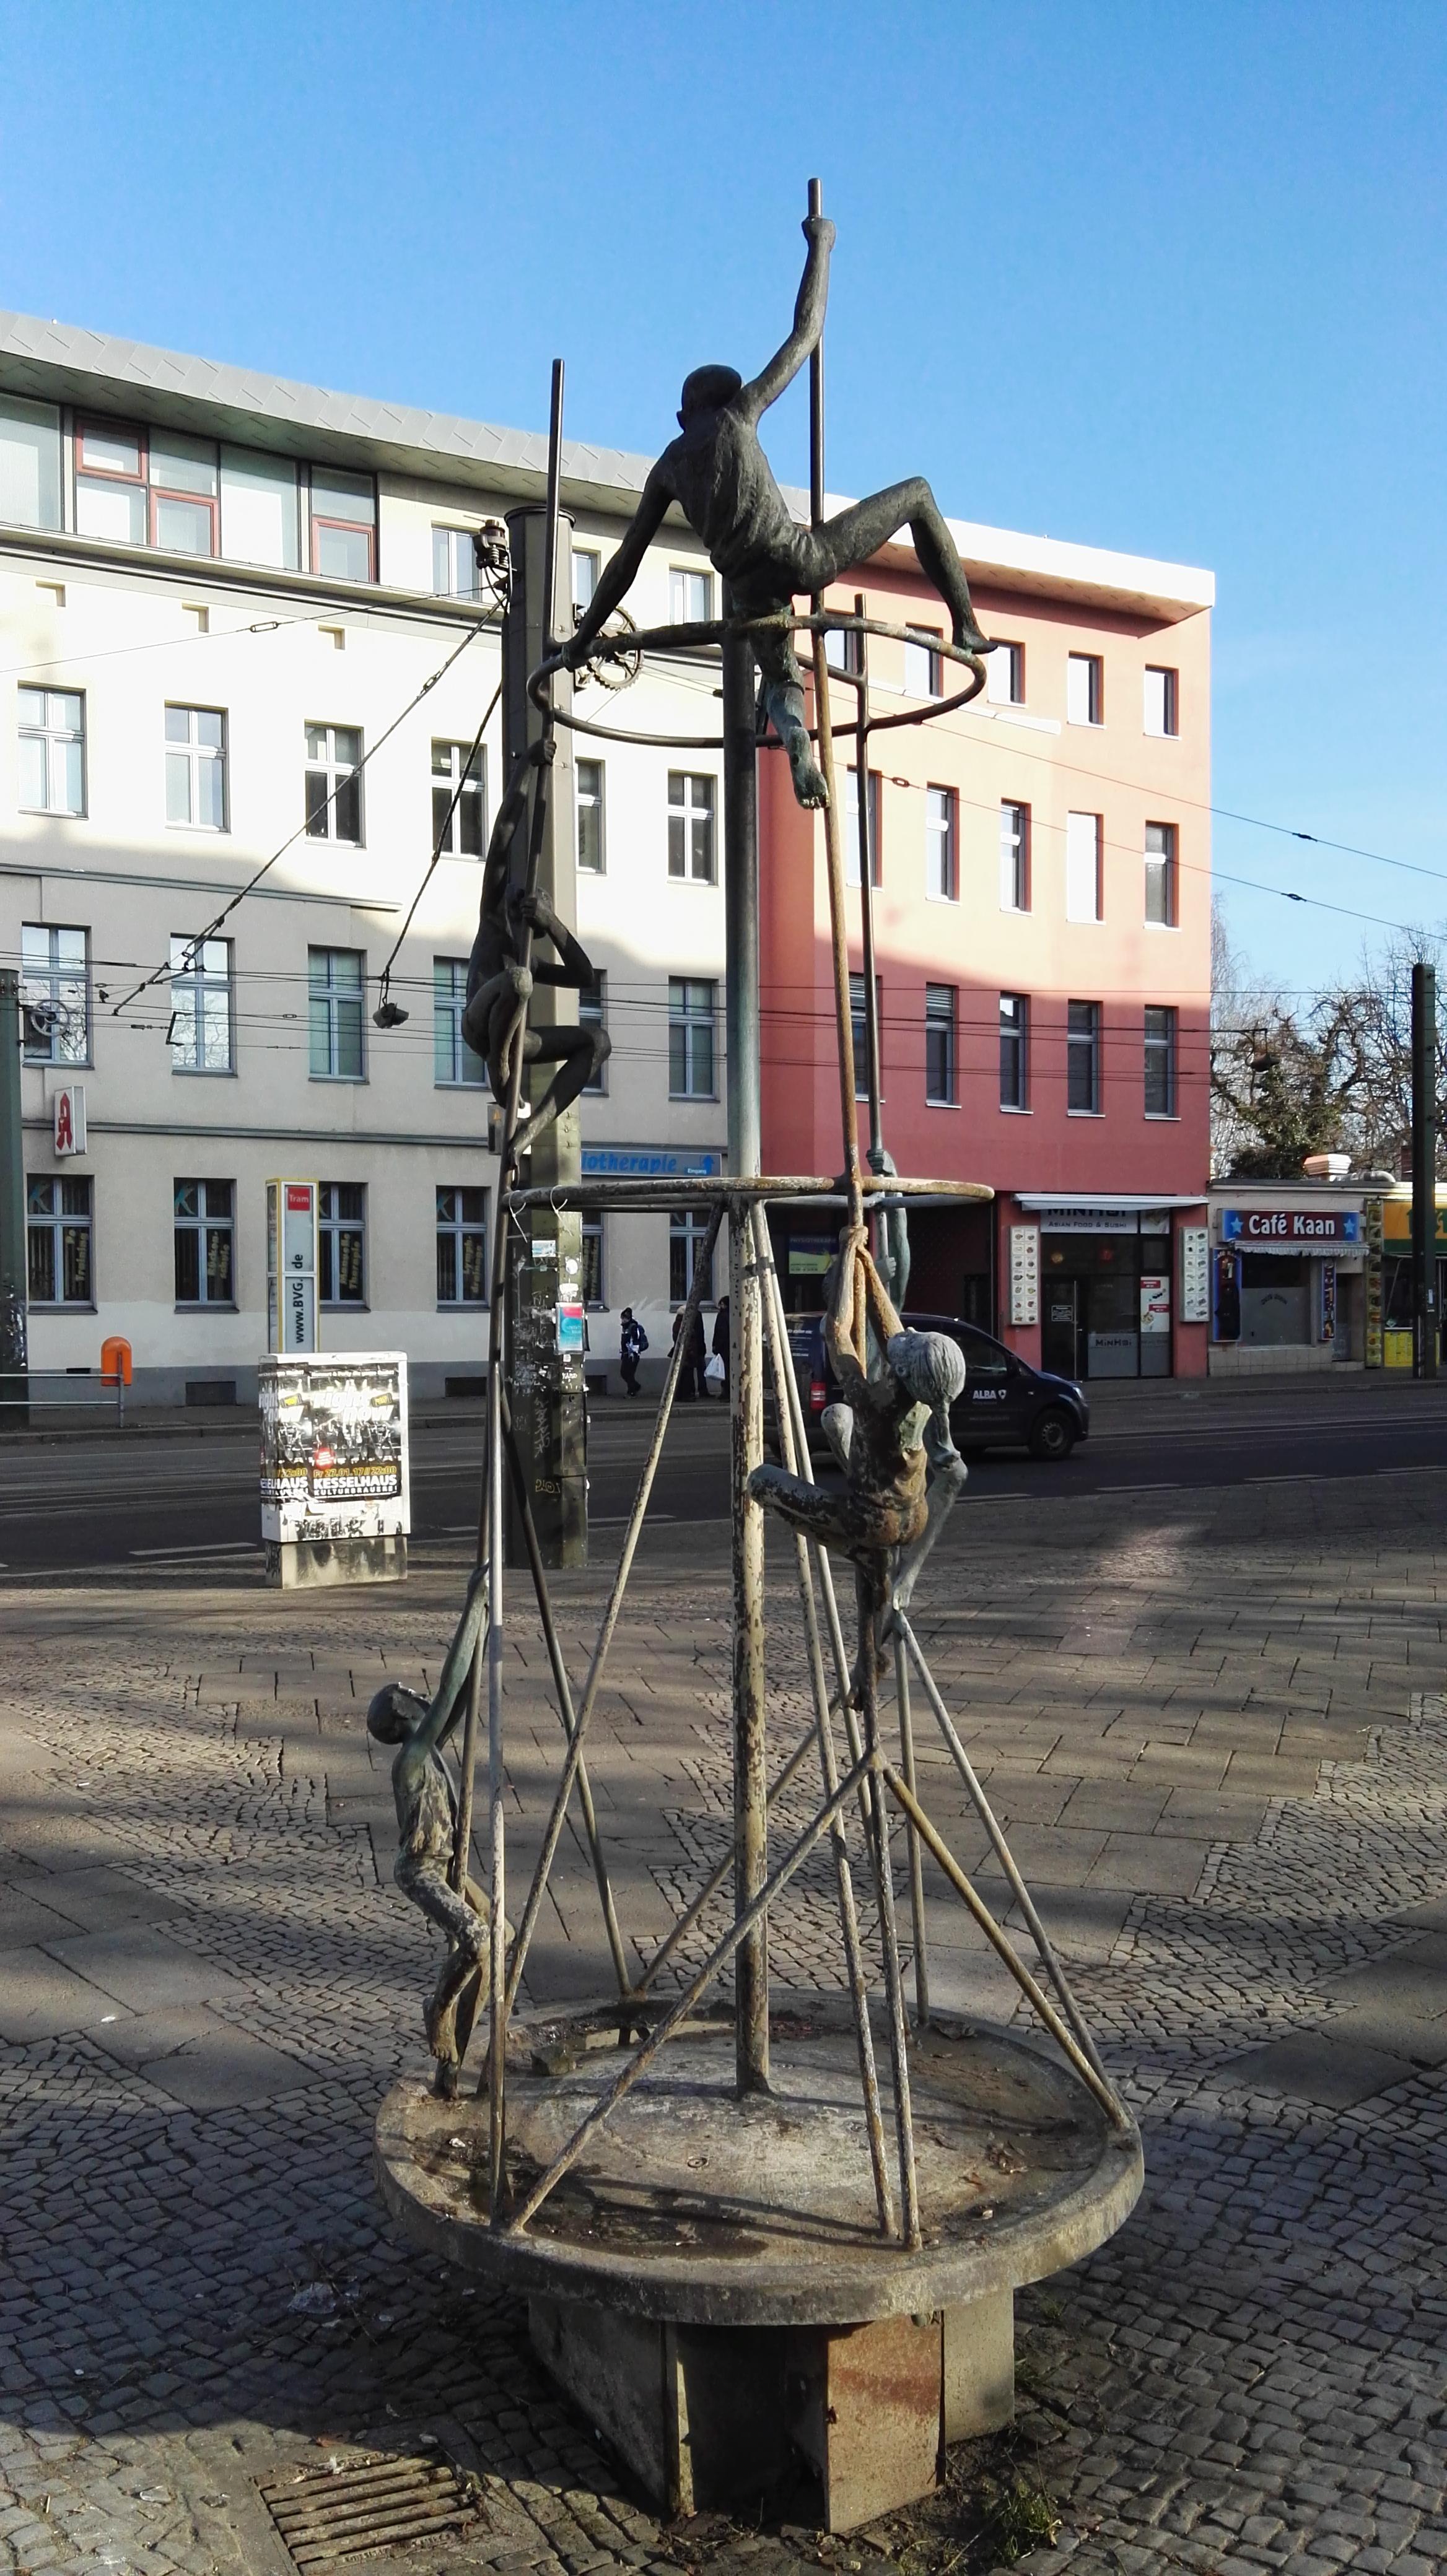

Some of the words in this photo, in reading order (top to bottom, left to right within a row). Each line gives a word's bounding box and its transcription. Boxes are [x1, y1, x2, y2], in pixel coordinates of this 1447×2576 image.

[289, 1193, 309, 1203] Tram
[1249, 1214, 1288, 1235] Café
[1293, 1216, 1336, 1235] Kaan
[349, 1240, 361, 1289] Therapie
[973, 1390, 997, 1399] ALBA
[342, 1405, 395, 1423] now
[313, 1474, 398, 1490] KESSELHAUS
